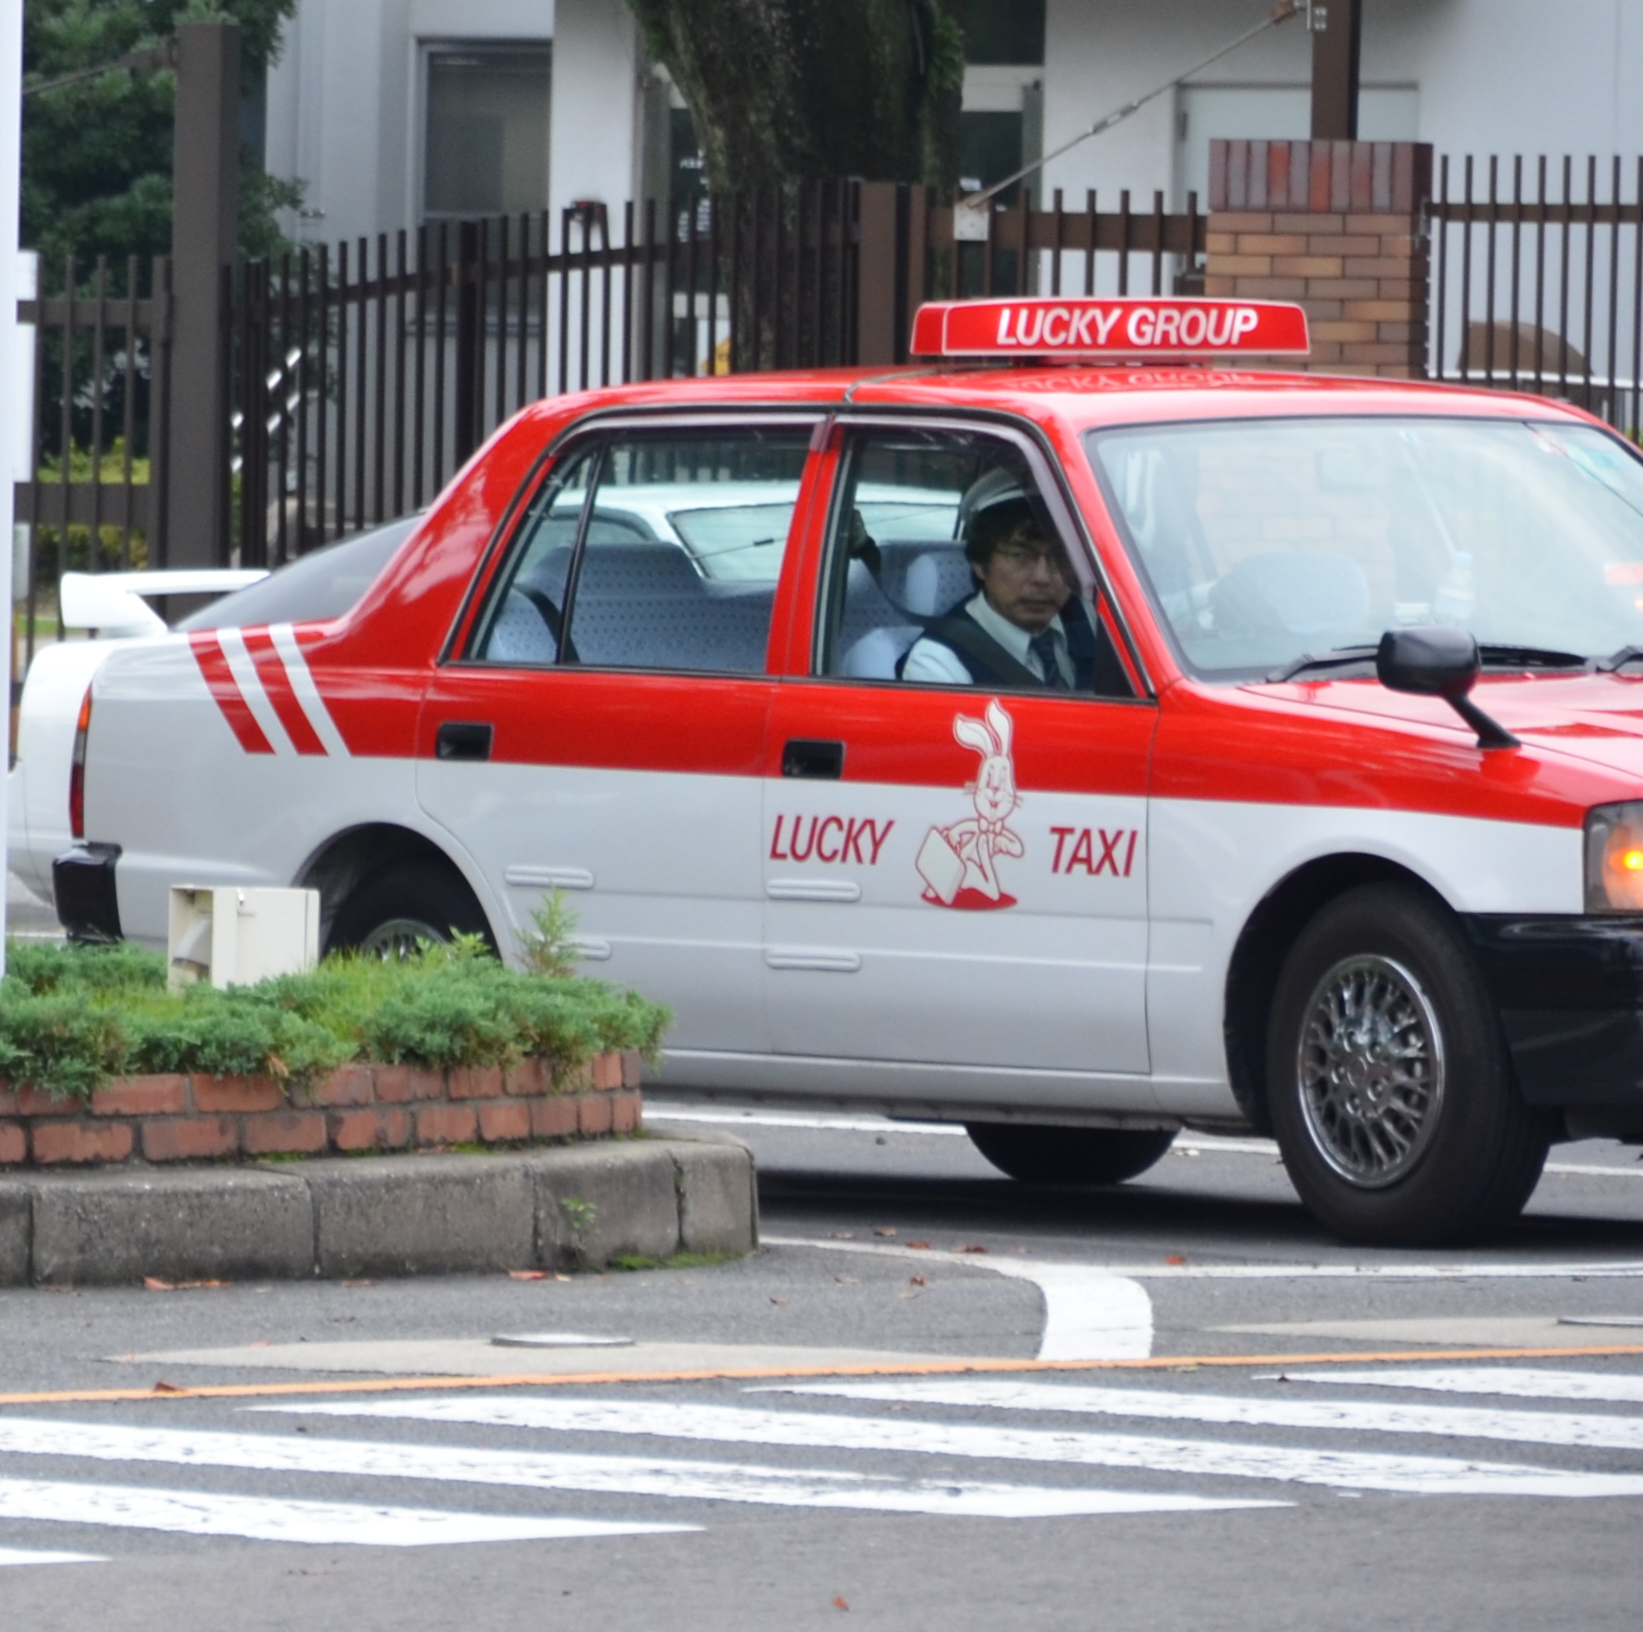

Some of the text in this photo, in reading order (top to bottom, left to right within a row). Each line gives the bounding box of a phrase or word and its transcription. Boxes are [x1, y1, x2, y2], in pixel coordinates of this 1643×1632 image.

[996, 307, 1259, 346] LUCKY GROUP
[769, 814, 1138, 878] LUCKY TAXI
